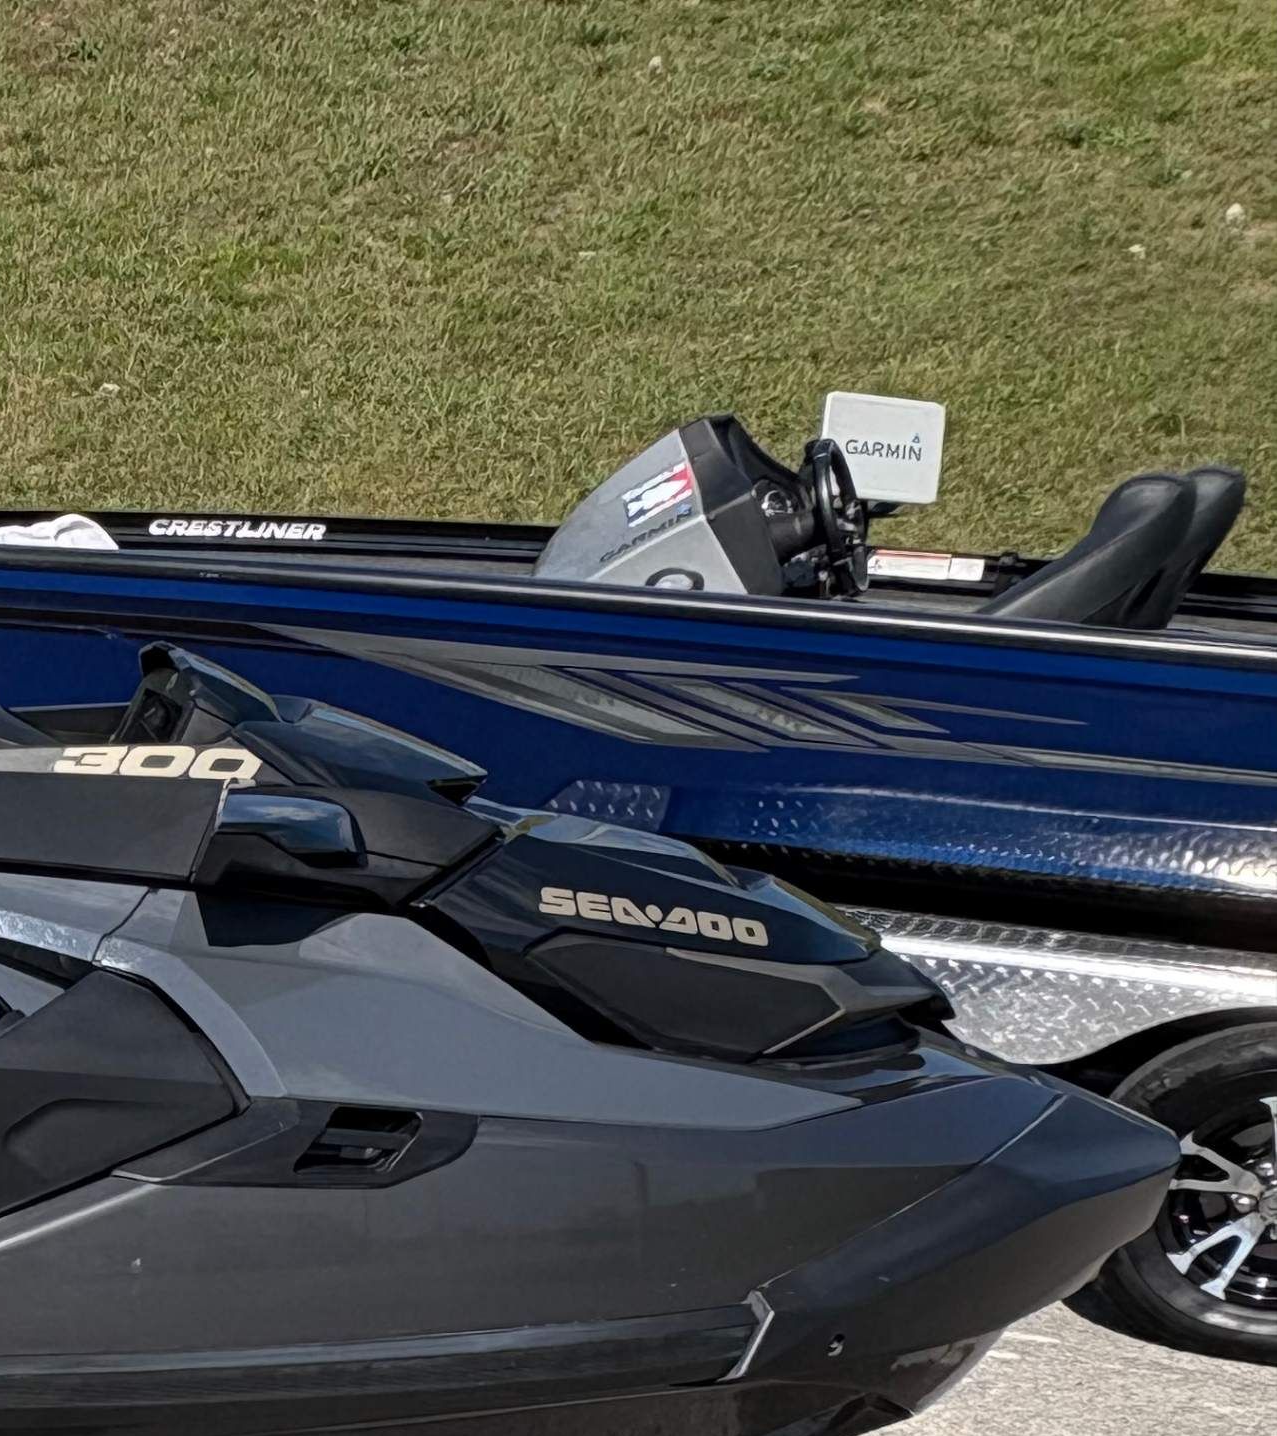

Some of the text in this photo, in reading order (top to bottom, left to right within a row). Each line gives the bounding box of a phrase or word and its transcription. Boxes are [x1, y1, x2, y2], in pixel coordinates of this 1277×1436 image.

[845, 439, 922, 461] GARMIN
[148, 518, 327, 541] CRESTLINER
[53, 745, 263, 780] 300
